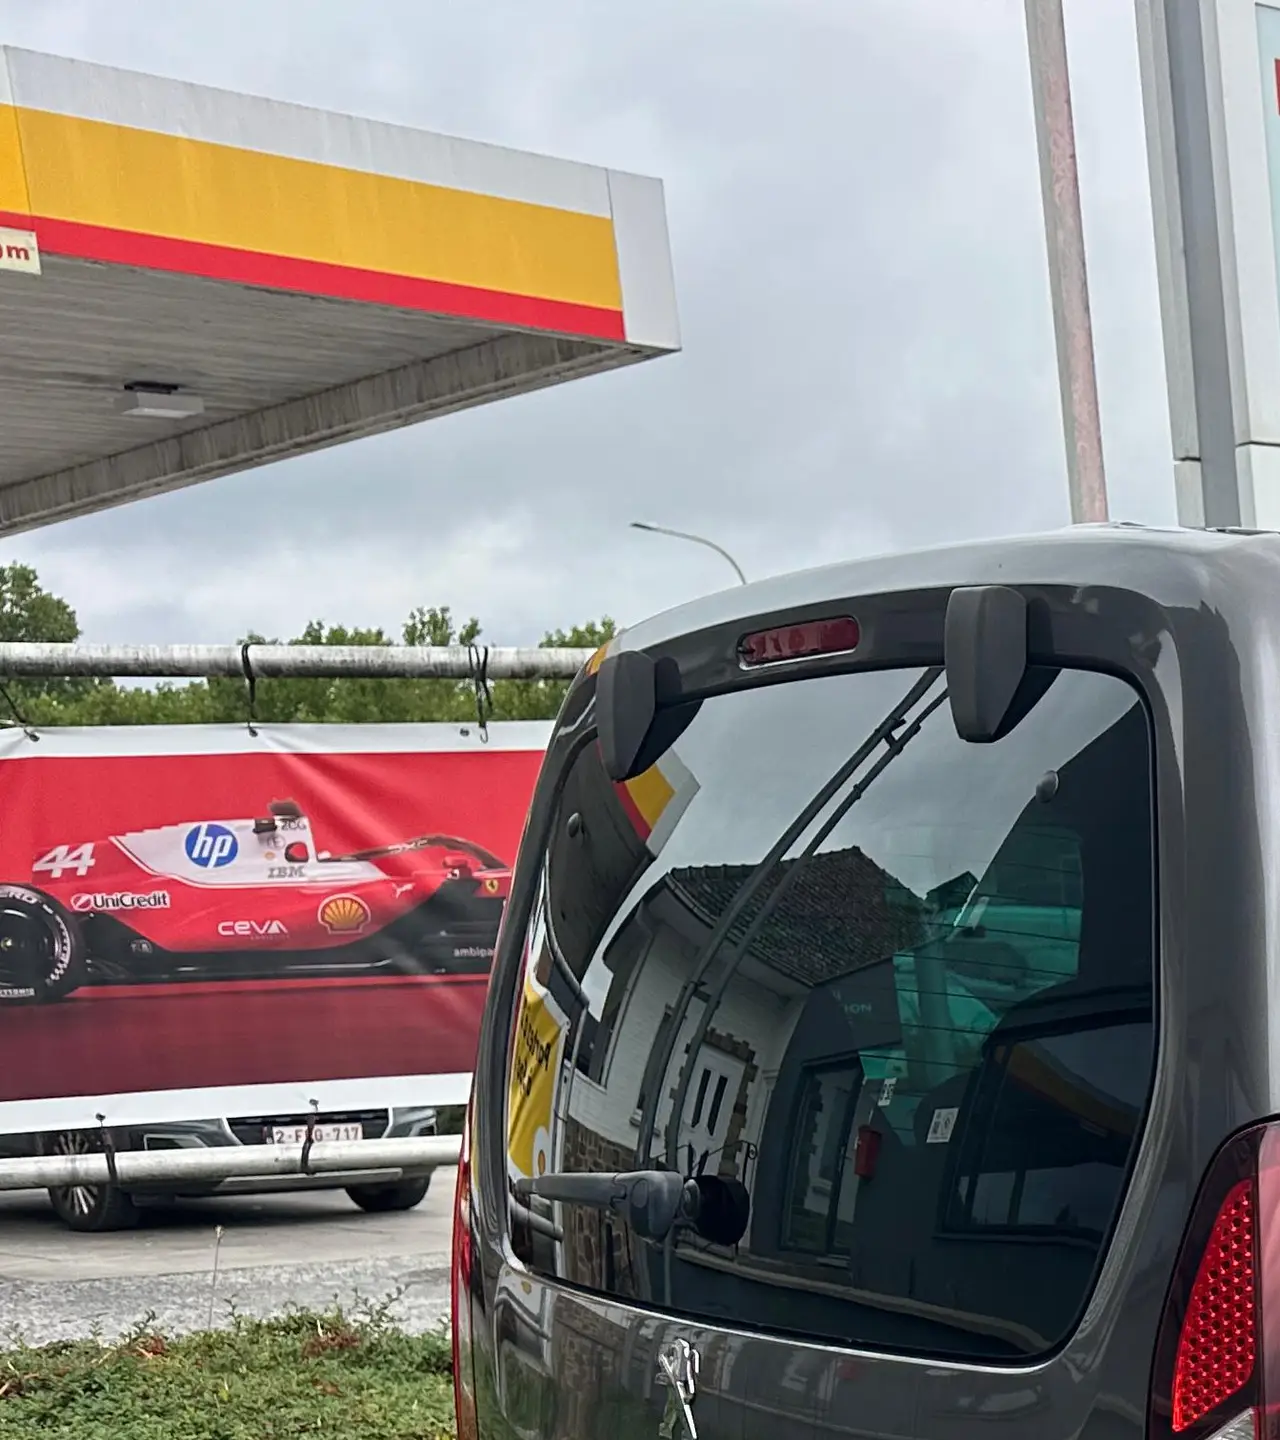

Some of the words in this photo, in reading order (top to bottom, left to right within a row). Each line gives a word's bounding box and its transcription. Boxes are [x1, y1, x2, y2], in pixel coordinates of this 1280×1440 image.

[191, 824, 233, 868] hp
[32, 842, 96, 878] 44
[267, 866, 306, 879] IBM
[92, 893, 168, 909] UniCredit
